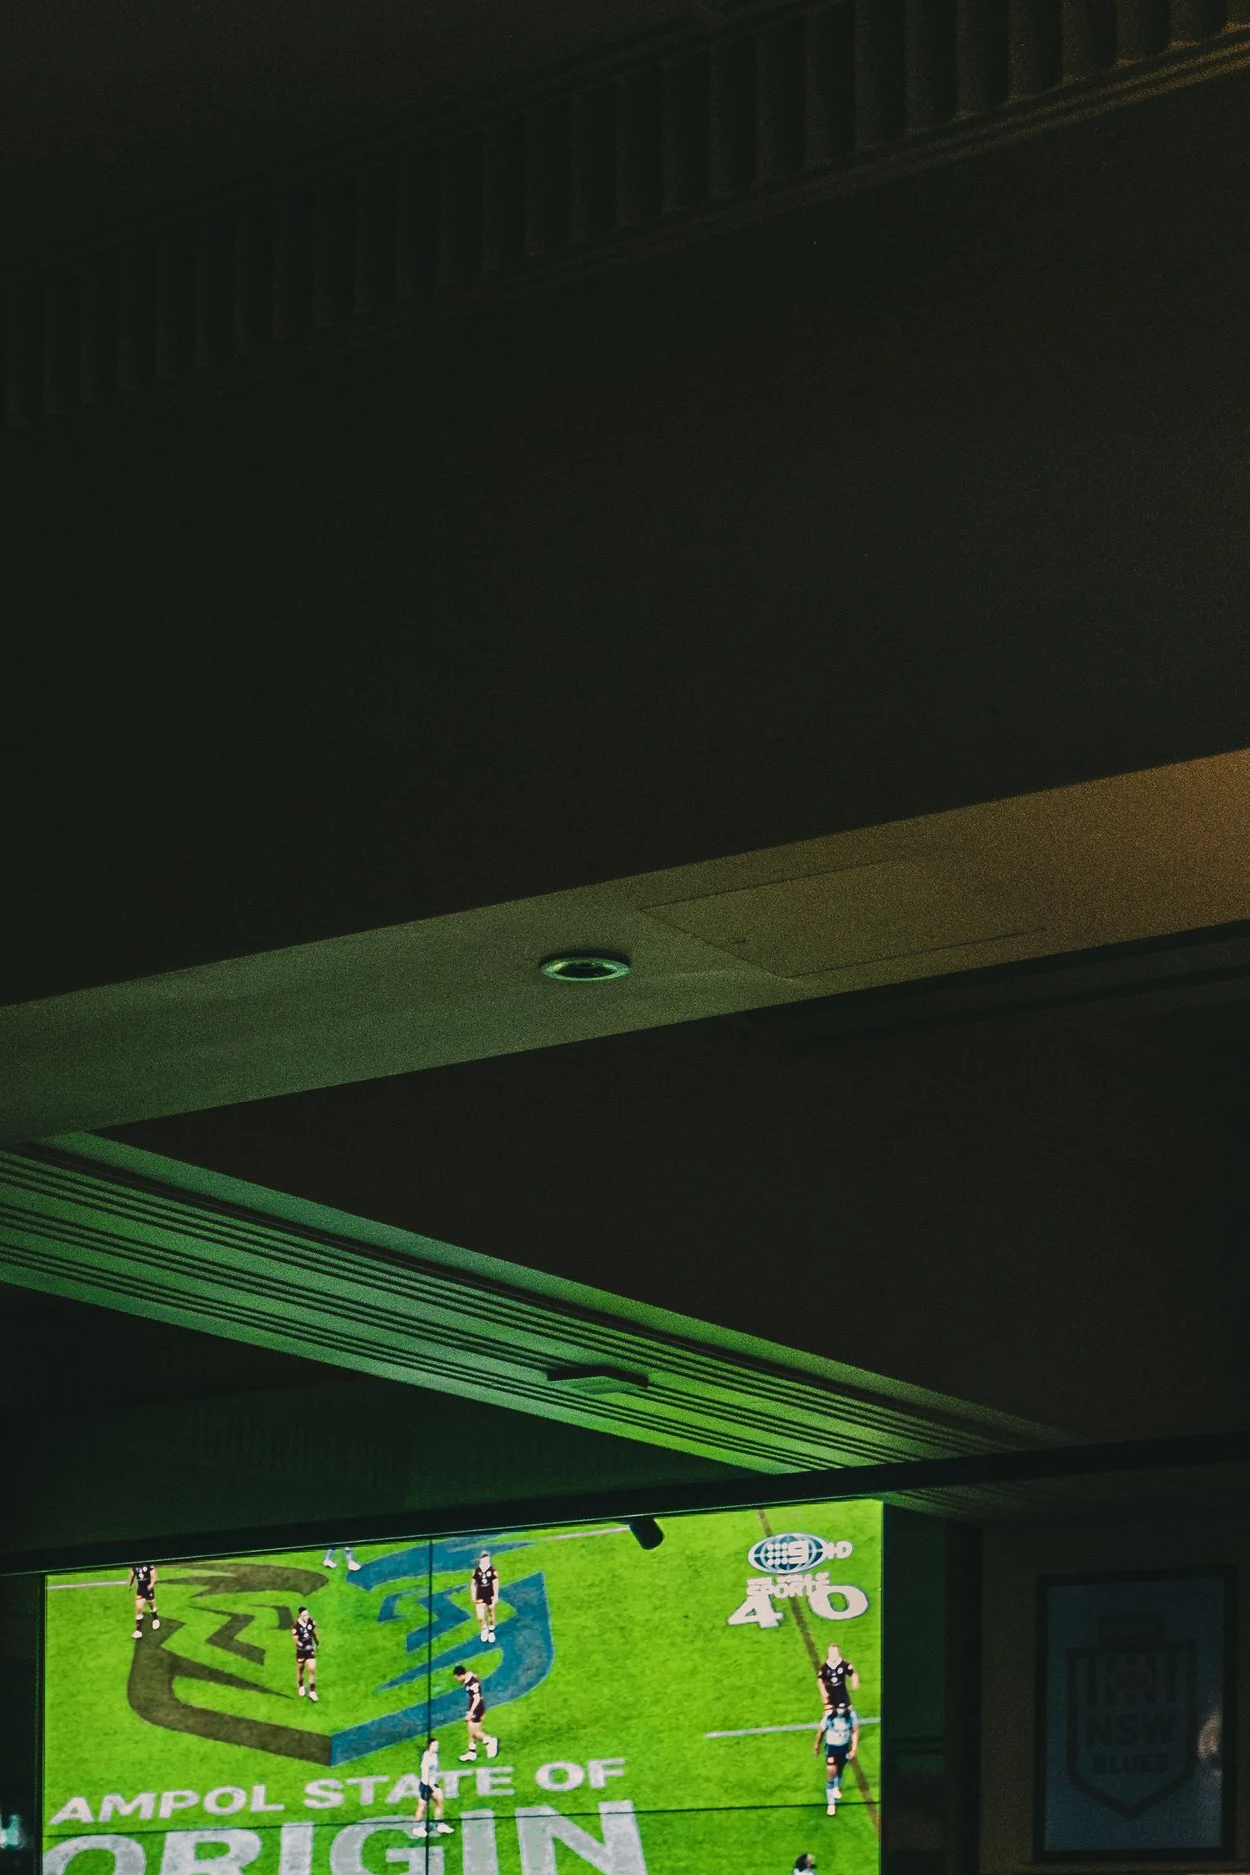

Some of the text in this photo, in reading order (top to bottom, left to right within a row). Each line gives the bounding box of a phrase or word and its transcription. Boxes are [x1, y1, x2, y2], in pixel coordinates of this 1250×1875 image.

[1086, 1711, 1175, 1748] NSW
[49, 1758, 626, 1825] AMPOL STATE OF
